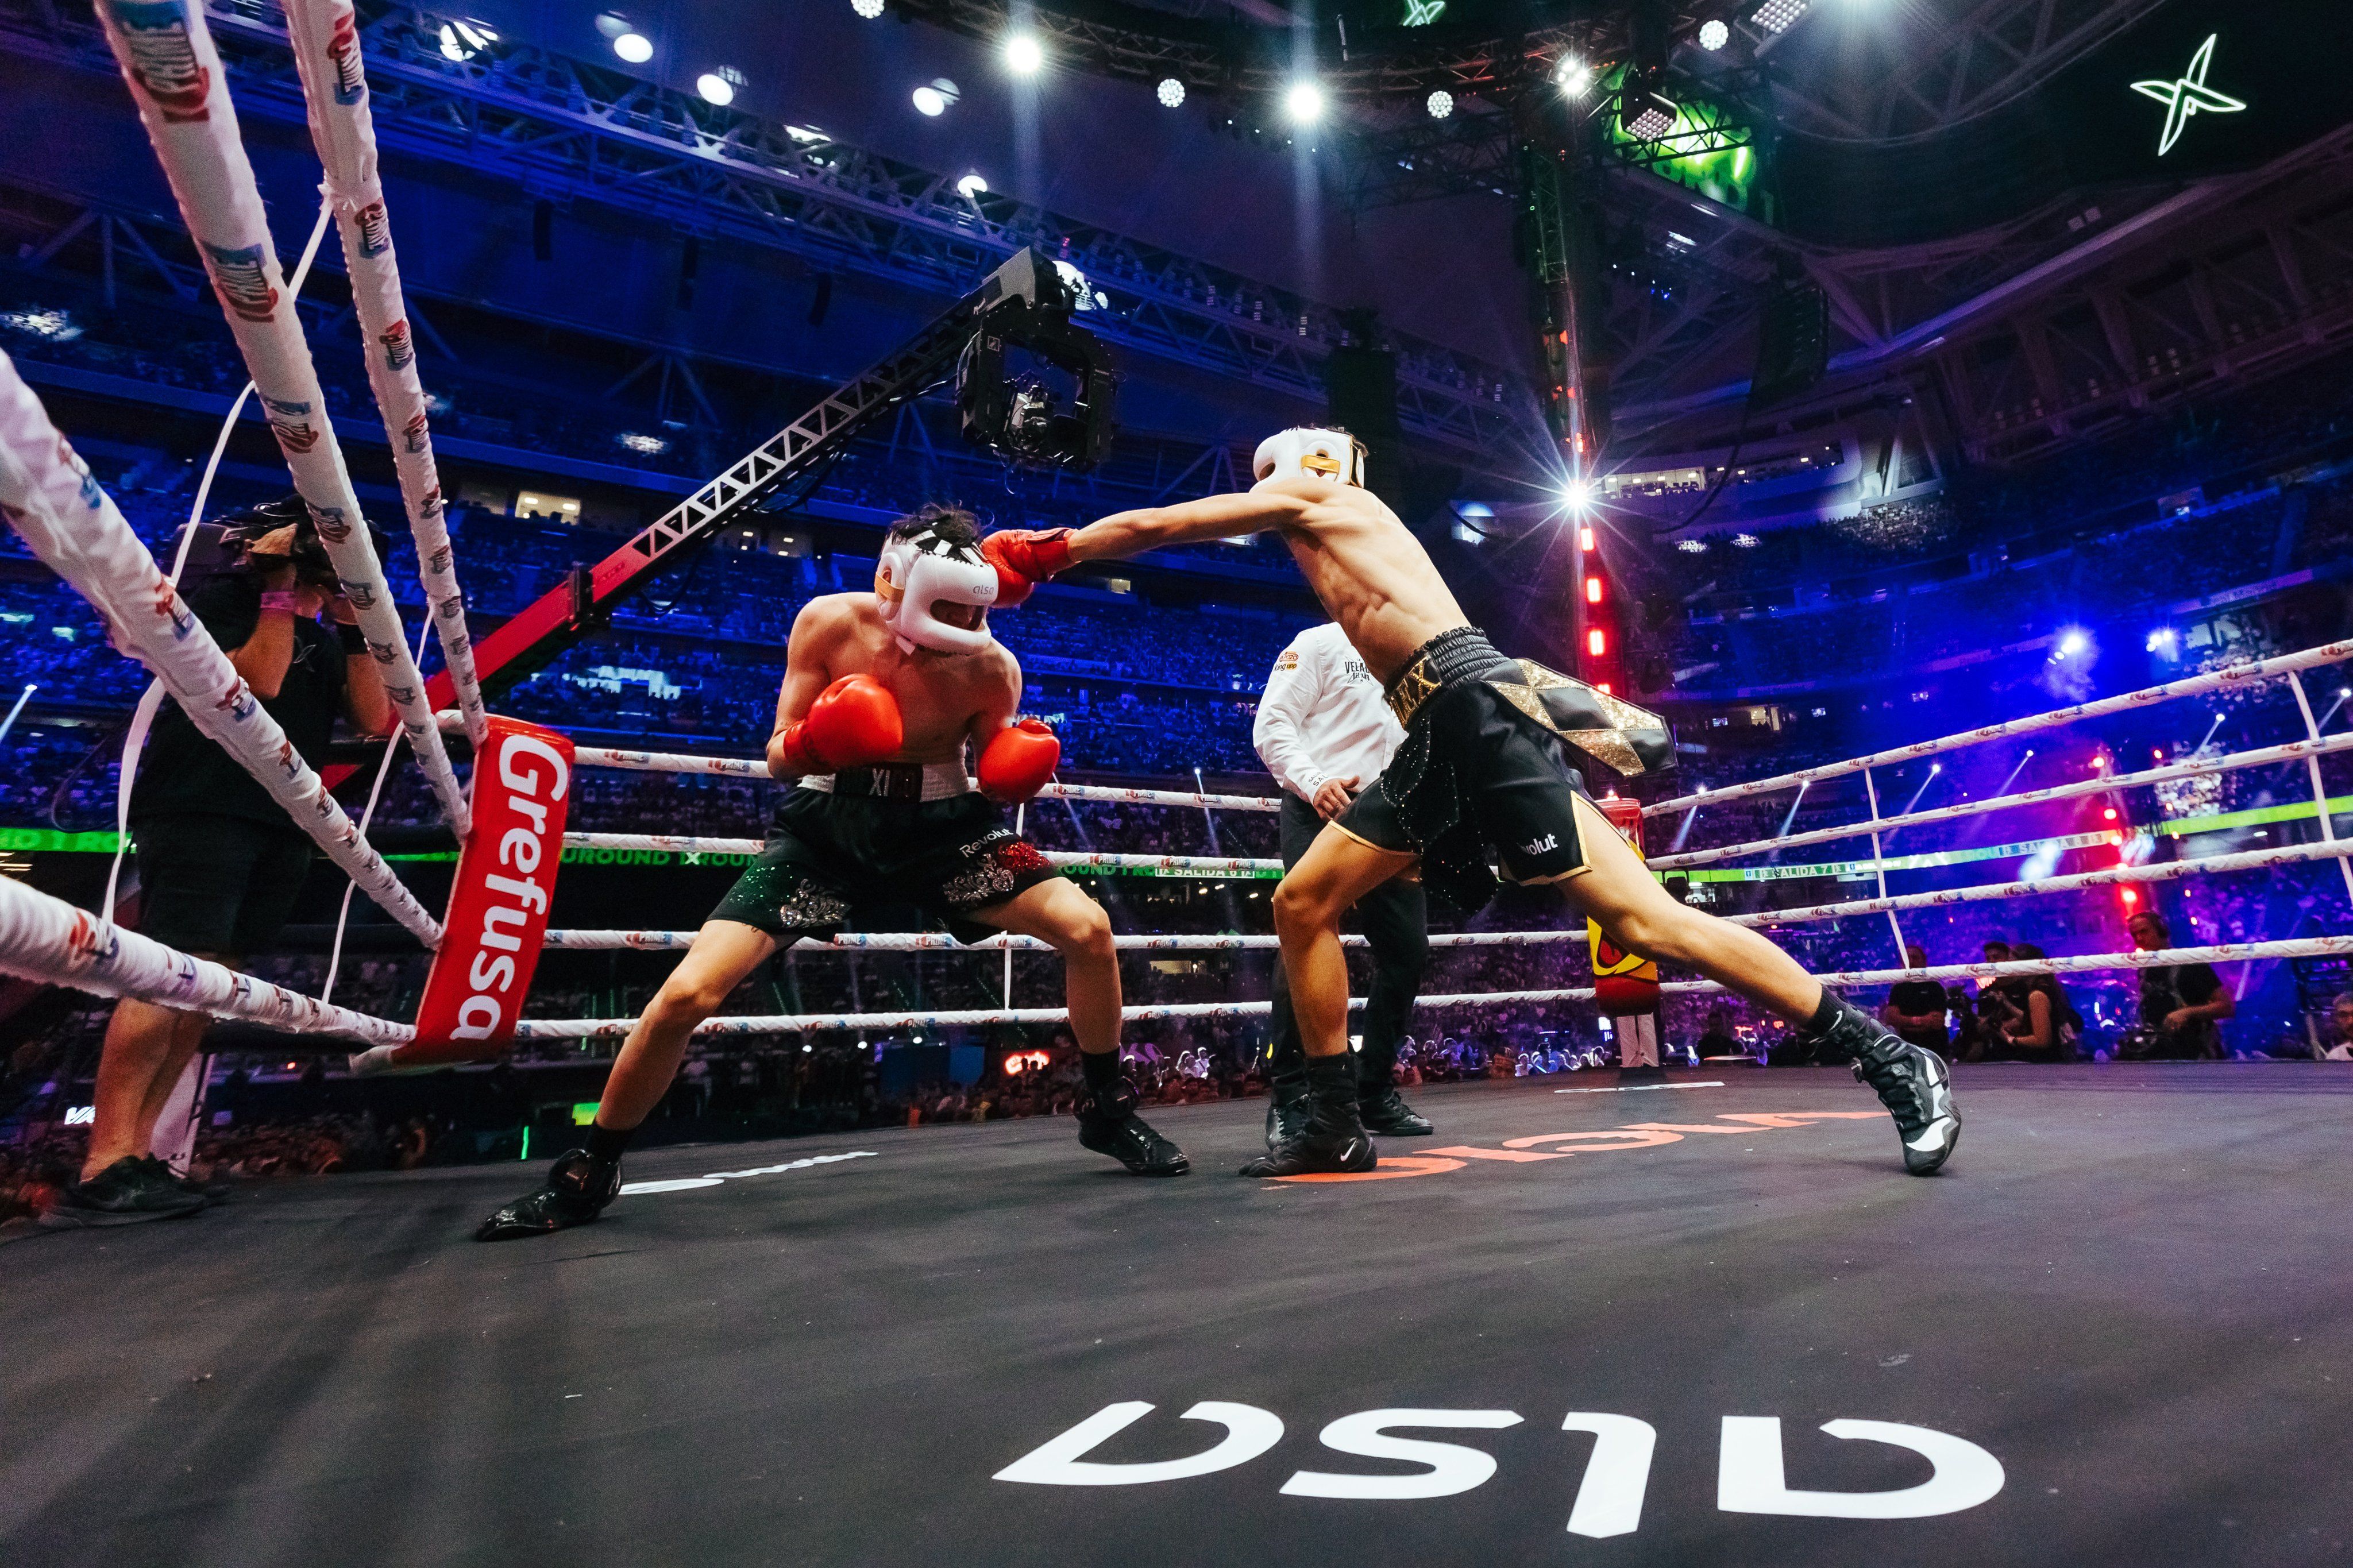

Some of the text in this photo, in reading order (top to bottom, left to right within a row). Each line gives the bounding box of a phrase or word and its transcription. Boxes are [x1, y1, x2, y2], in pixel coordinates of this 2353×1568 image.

[973, 585, 994, 595] alsa
[869, 768, 890, 797] XI
[1063, 786, 1081, 795] PRIME
[959, 828, 1013, 858] Revolut
[1099, 855, 1117, 864] PRIME
[1170, 857, 1187, 866] PRIME
[1236, 860, 1252, 869] PRIME
[1819, 866, 1827, 874] 7
[450, 736, 568, 1040] Grefusa
[838, 935, 861, 945] PRIME
[925, 936, 947, 947] PRIME
[992, 1400, 2005, 1538] alsa
